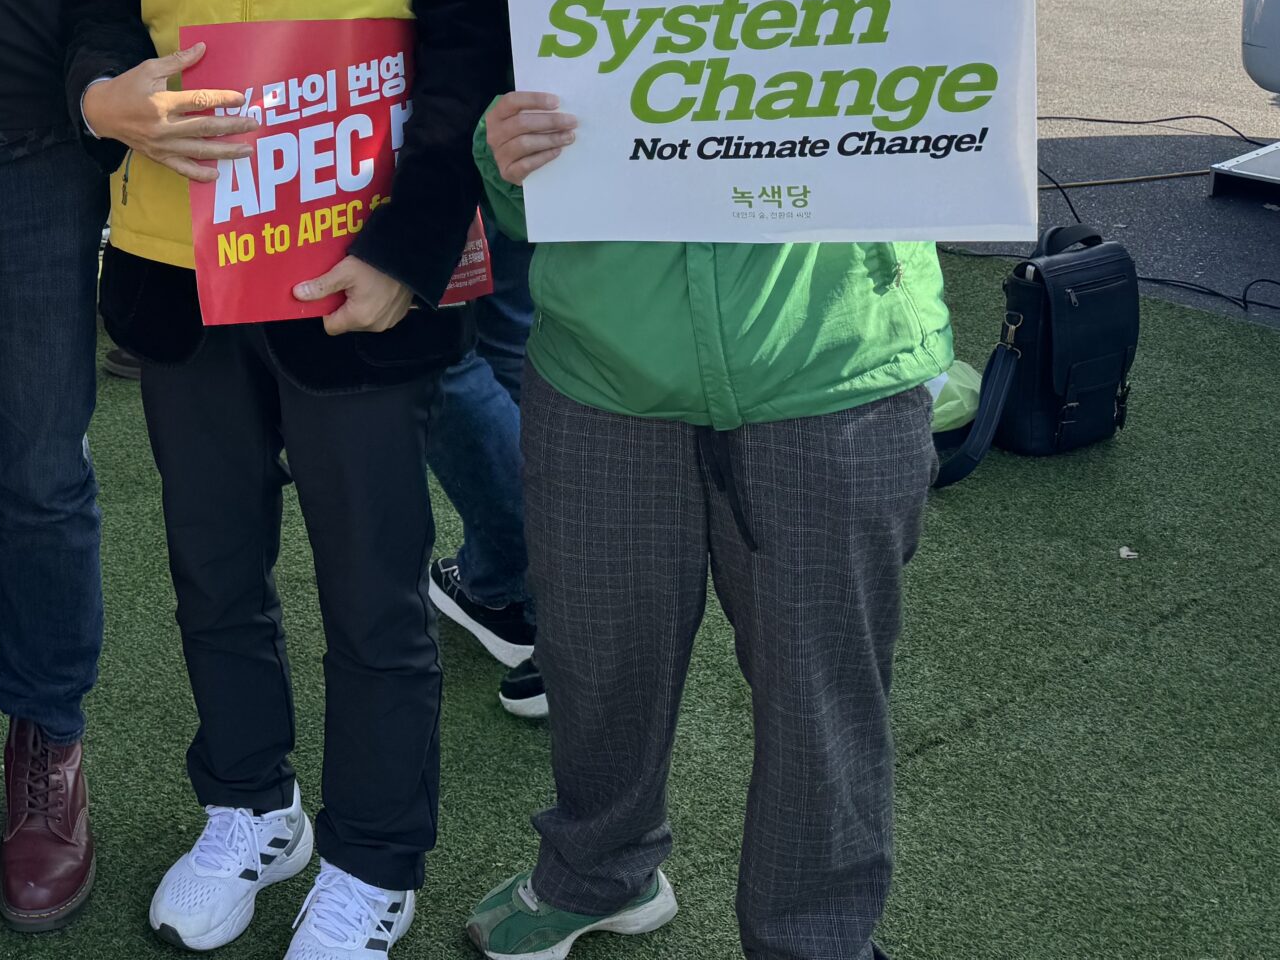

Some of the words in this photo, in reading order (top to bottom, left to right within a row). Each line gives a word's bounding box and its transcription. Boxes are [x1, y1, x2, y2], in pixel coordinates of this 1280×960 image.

[348, 51, 406, 107] 번영
[629, 57, 999, 132] Change
[213, 113, 375, 224] APEC
[629, 137, 691, 161] Not
[696, 135, 830, 160] Climate
[837, 127, 989, 160] Change!
[731, 184, 812, 209] 녹색당
[217, 231, 255, 267] No
[261, 223, 291, 255] to
[297, 199, 364, 247] APEC
